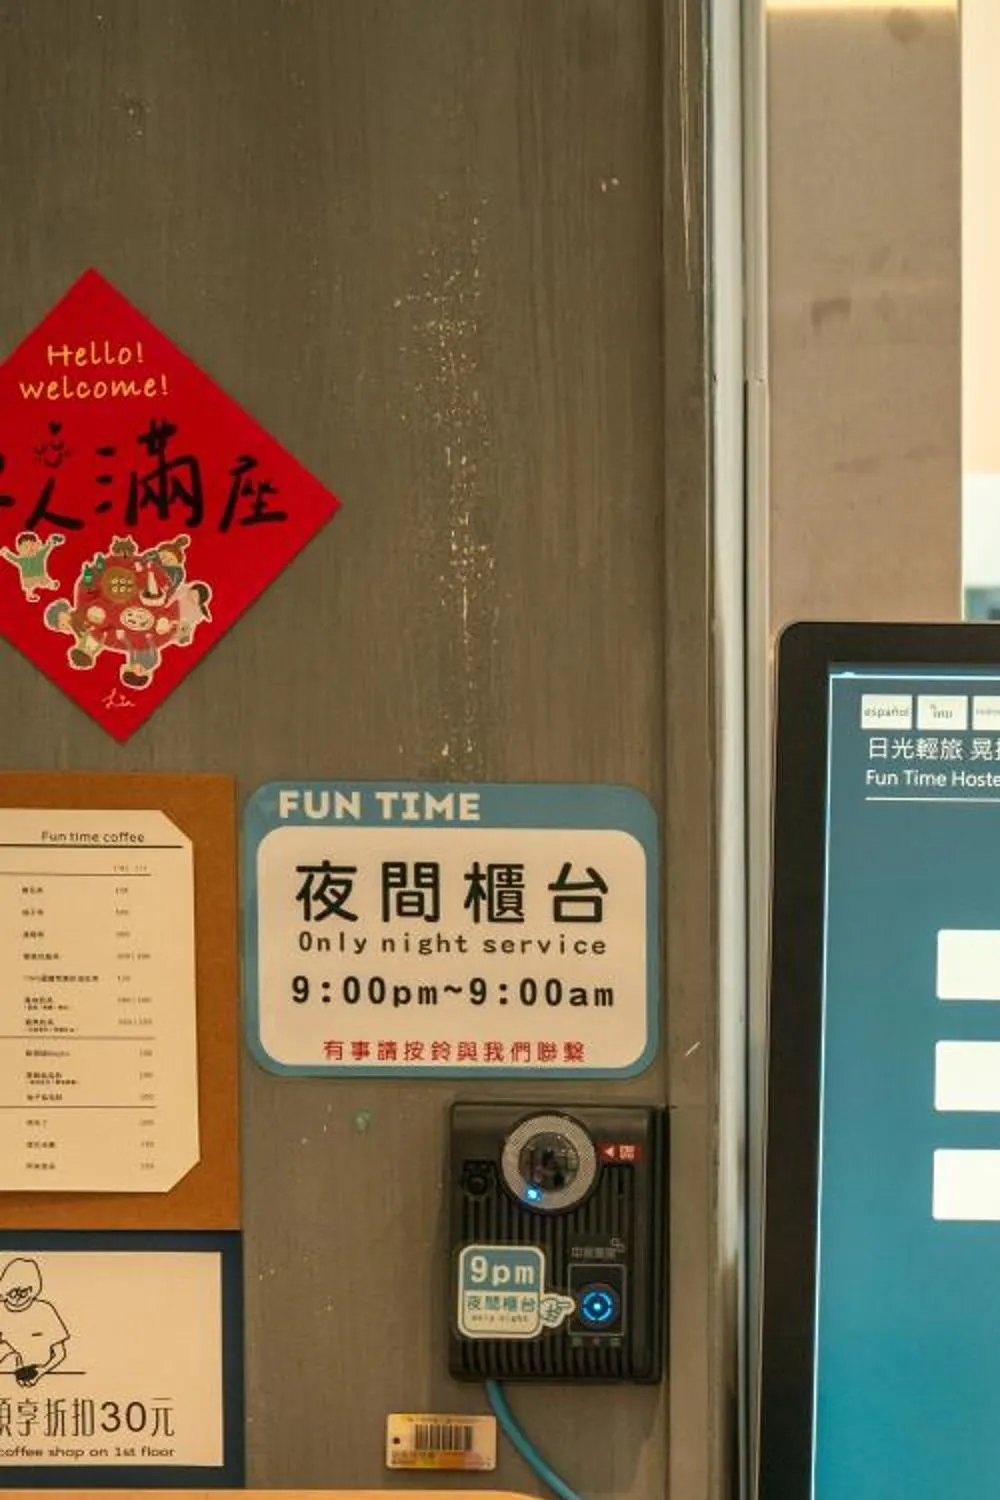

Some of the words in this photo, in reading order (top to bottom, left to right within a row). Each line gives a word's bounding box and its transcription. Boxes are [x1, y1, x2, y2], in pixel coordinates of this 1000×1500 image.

[47, 340, 145, 366] Hello!
[19, 373, 169, 400] welcome!
[0, 418, 288, 533] 人滿座
[863, 705, 910, 719] español
[868, 737, 963, 760] 日光輕旅
[865, 769, 899, 786] Fun
[902, 770, 947, 787] Time
[279, 789, 361, 820] FUN
[375, 791, 481, 821] TIME
[41, 830, 68, 844] Fun
[69, 830, 100, 844] time
[102, 830, 146, 844] coffee
[295, 860, 609, 924] 夜間櫃台
[299, 931, 368, 955] Only
[381, 931, 469, 956] night
[483, 934, 607, 956] service
[291, 975, 615, 1008] 9:00pm~9:00am
[323, 1039, 586, 1064] 有事請按鈴與我們聯繫
[470, 1255, 535, 1287] 9pm
[49, 1446, 85, 1460] shop
[89, 1449, 109, 1457] on
[115, 1447, 136, 1457] 1st
[141, 1446, 175, 1457] floor
